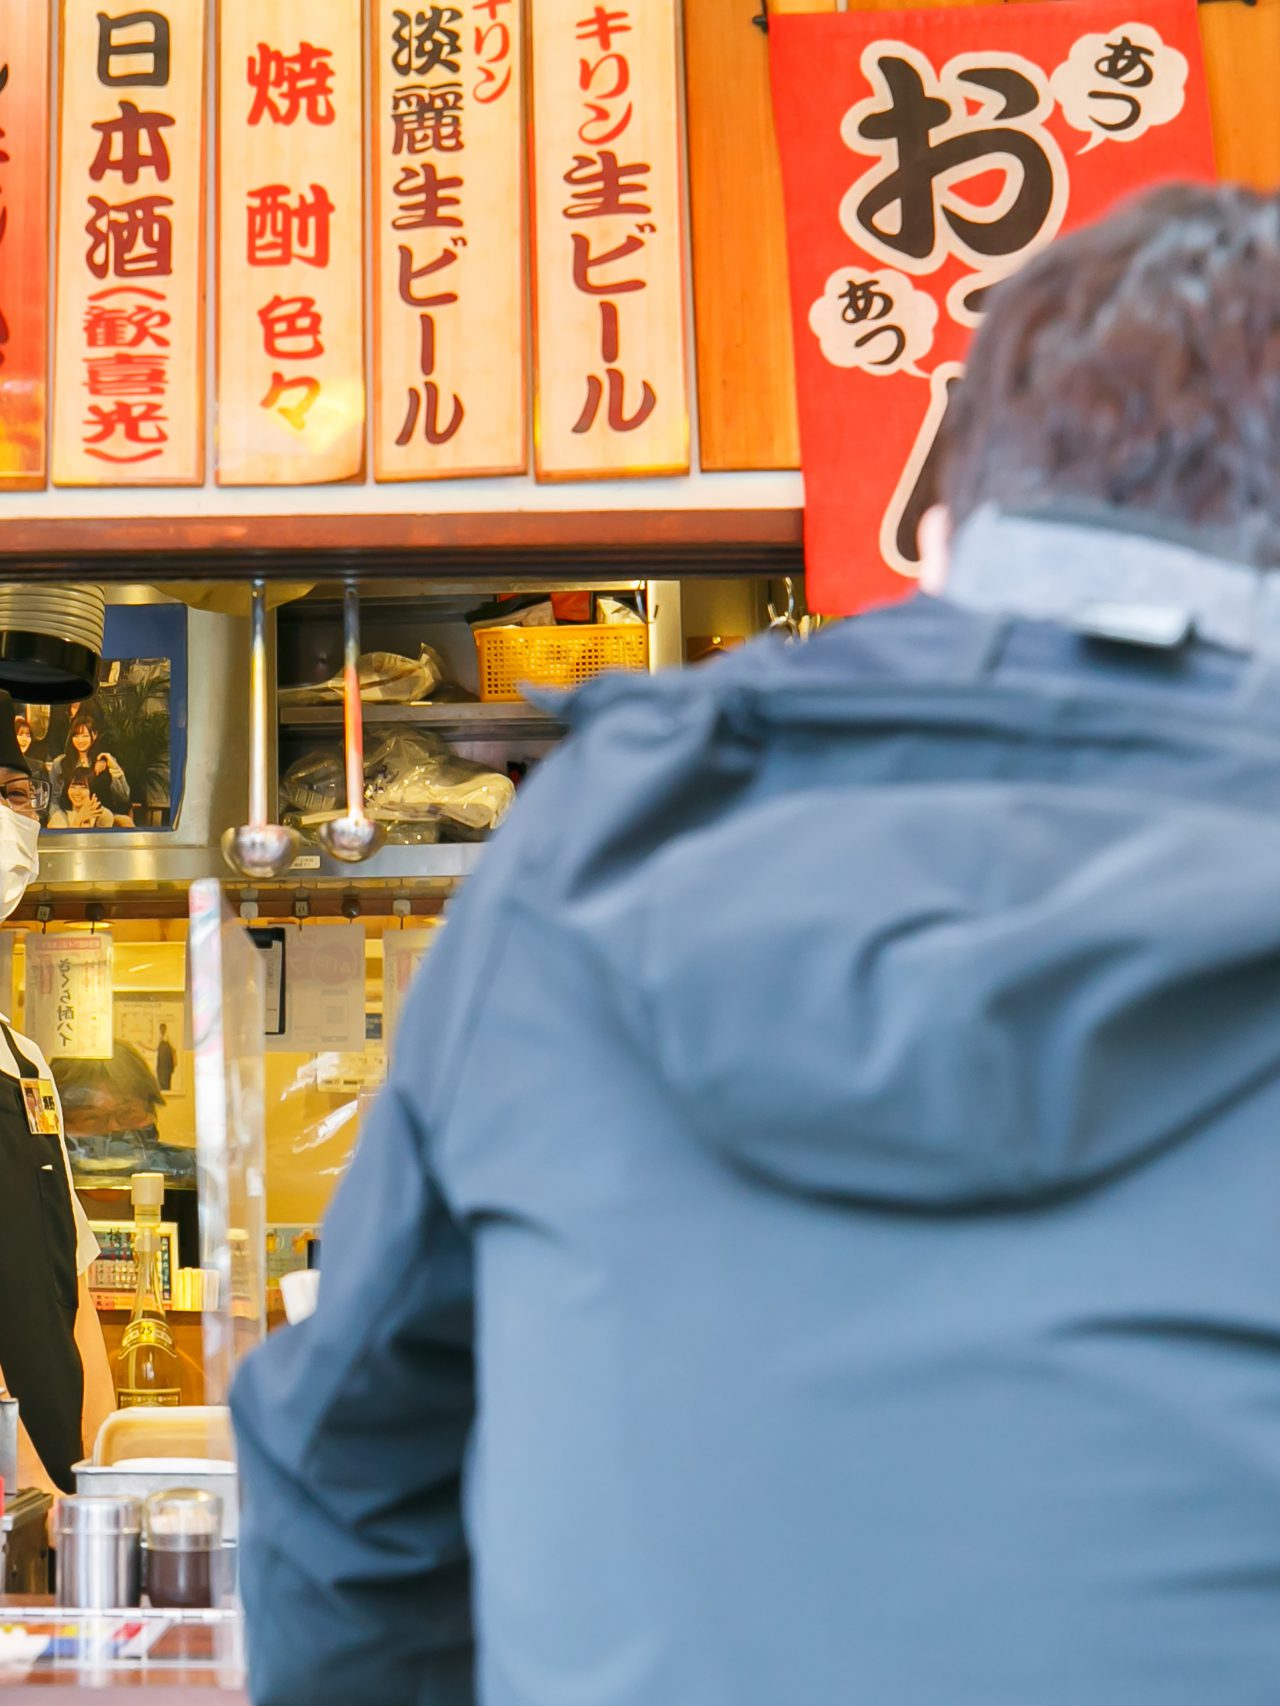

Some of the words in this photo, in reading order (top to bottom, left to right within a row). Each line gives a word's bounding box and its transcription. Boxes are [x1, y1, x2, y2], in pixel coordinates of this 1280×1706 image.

[246, 42, 336, 430] 焼酎色々
[390, 5, 467, 447] 淡麗生ビール
[563, 5, 655, 435] キリン生ビール
[1088, 37, 1154, 131] あつ
[838, 279, 906, 366] あつ
